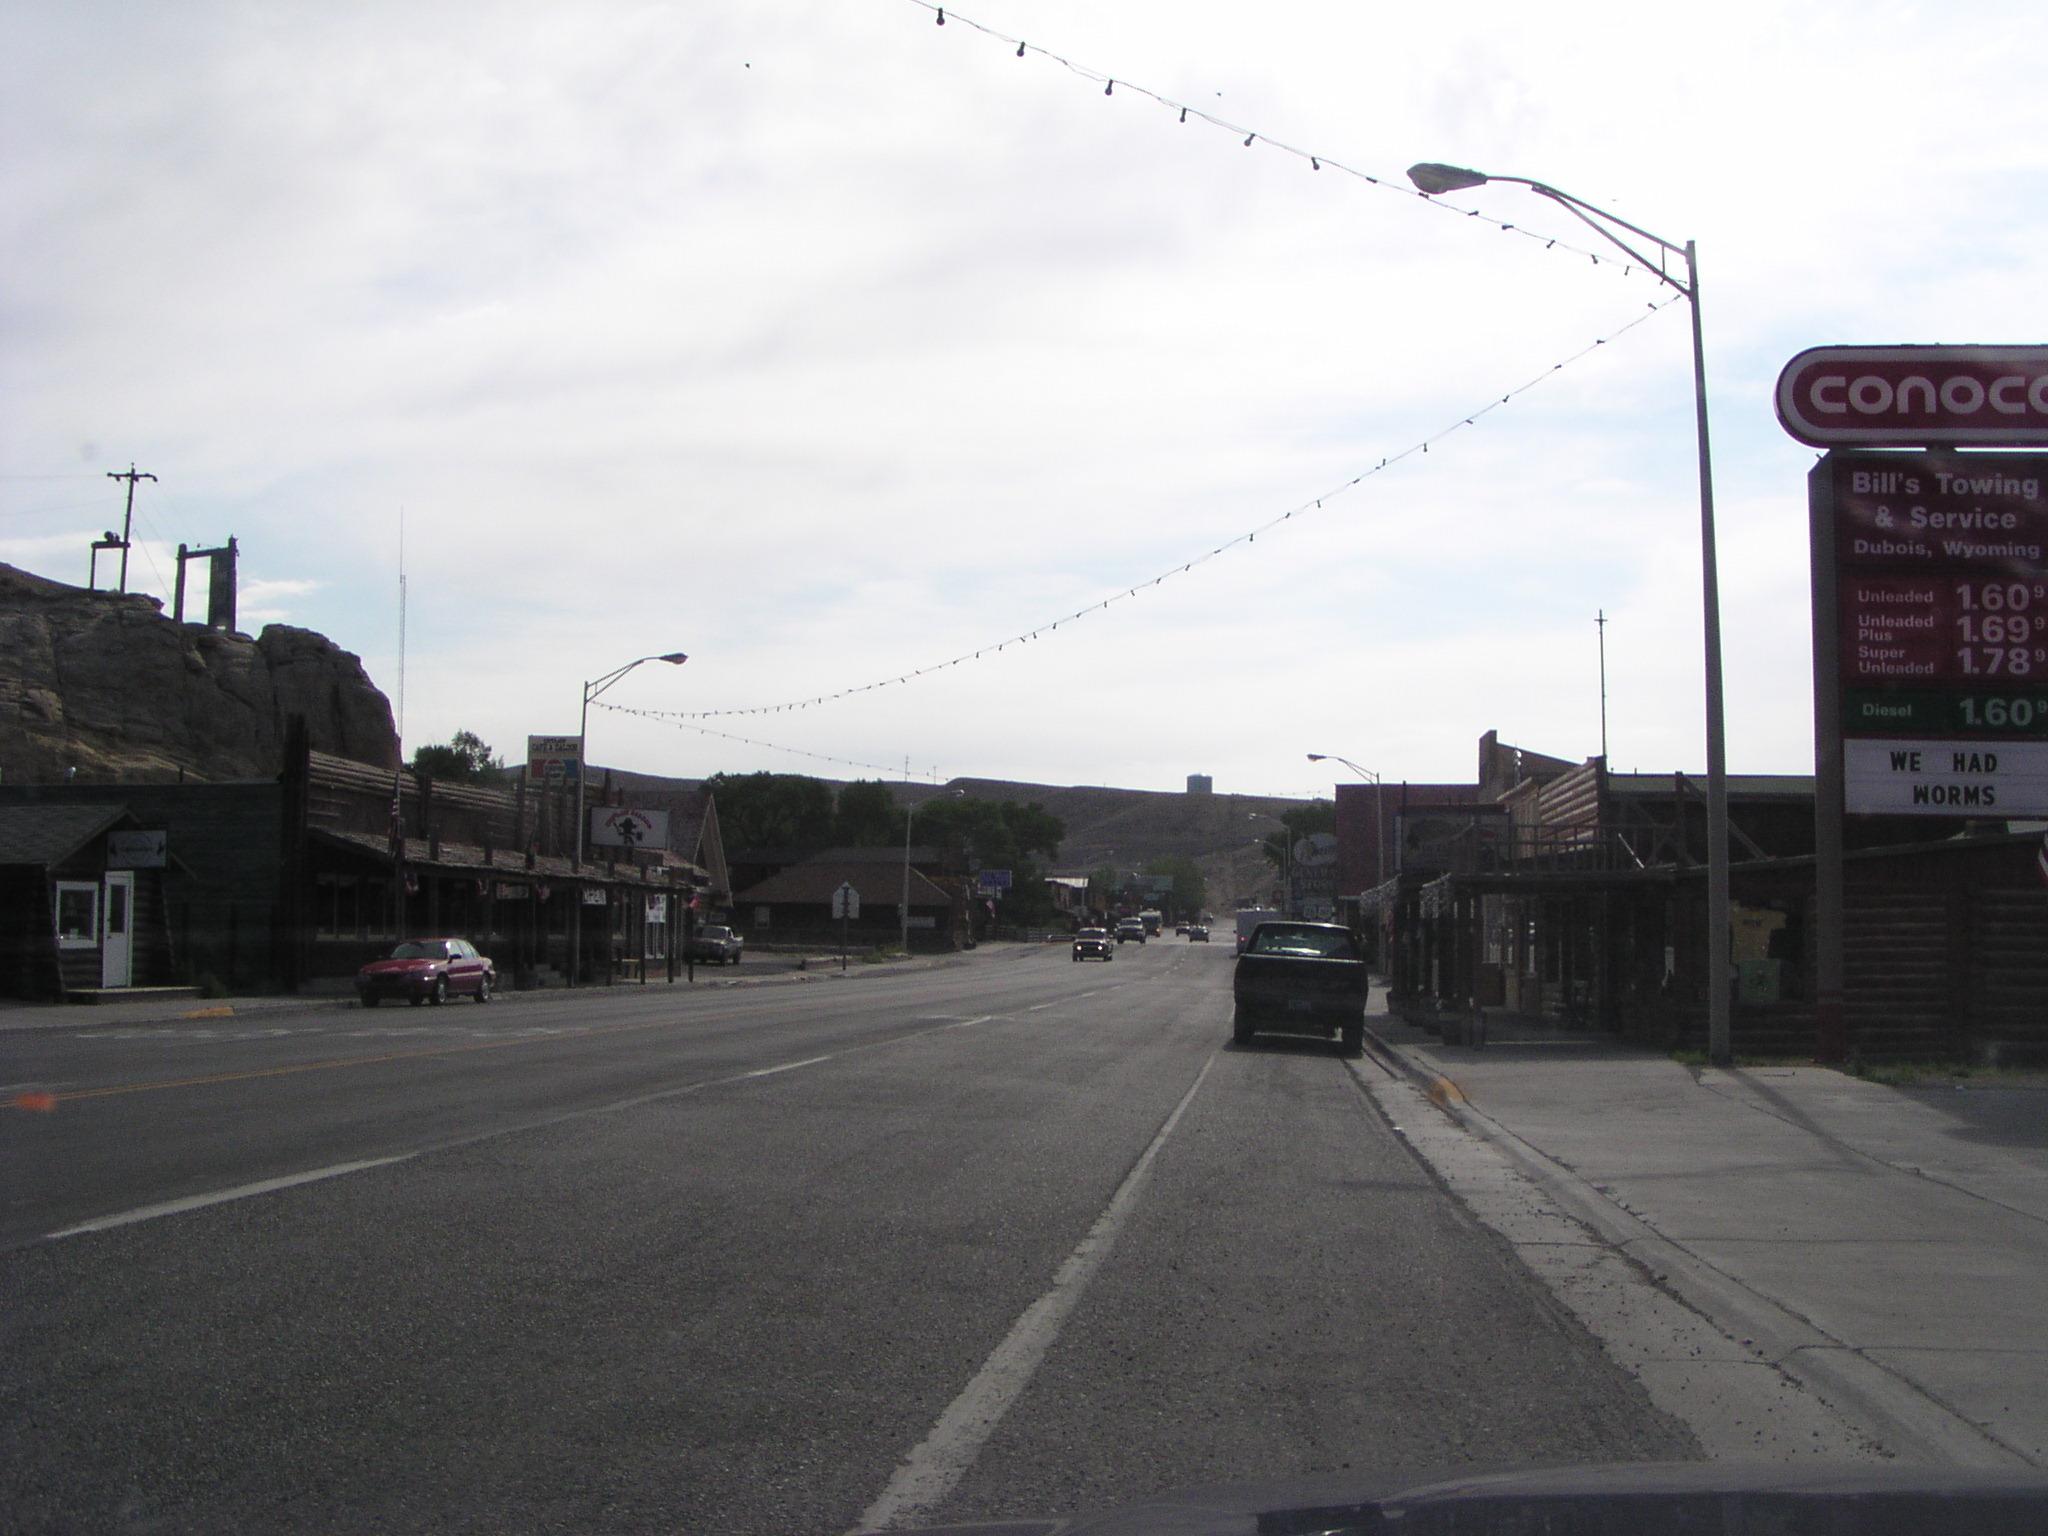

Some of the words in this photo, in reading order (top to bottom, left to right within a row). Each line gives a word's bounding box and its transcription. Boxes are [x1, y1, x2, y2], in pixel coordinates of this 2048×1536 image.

[1852, 471, 1921, 494] Bill's
[1936, 472, 2039, 500] Towing
[1875, 506, 1894, 529] &
[1910, 506, 2017, 529] Service
[1854, 539, 1933, 558] Dubois,
[1943, 541, 2041, 559] Wyoming
[1858, 590, 1934, 602] Unleaded
[1858, 615, 1934, 628] Unleaded
[1858, 629, 1893, 641] Plus
[1858, 645, 1905, 660] Super
[1859, 661, 1935, 674] Unleaded
[1862, 703, 1912, 716] Diesel
[1890, 752, 1921, 771] WE
[1953, 753, 1997, 772] HAD
[1913, 785, 1995, 806] WORMS
